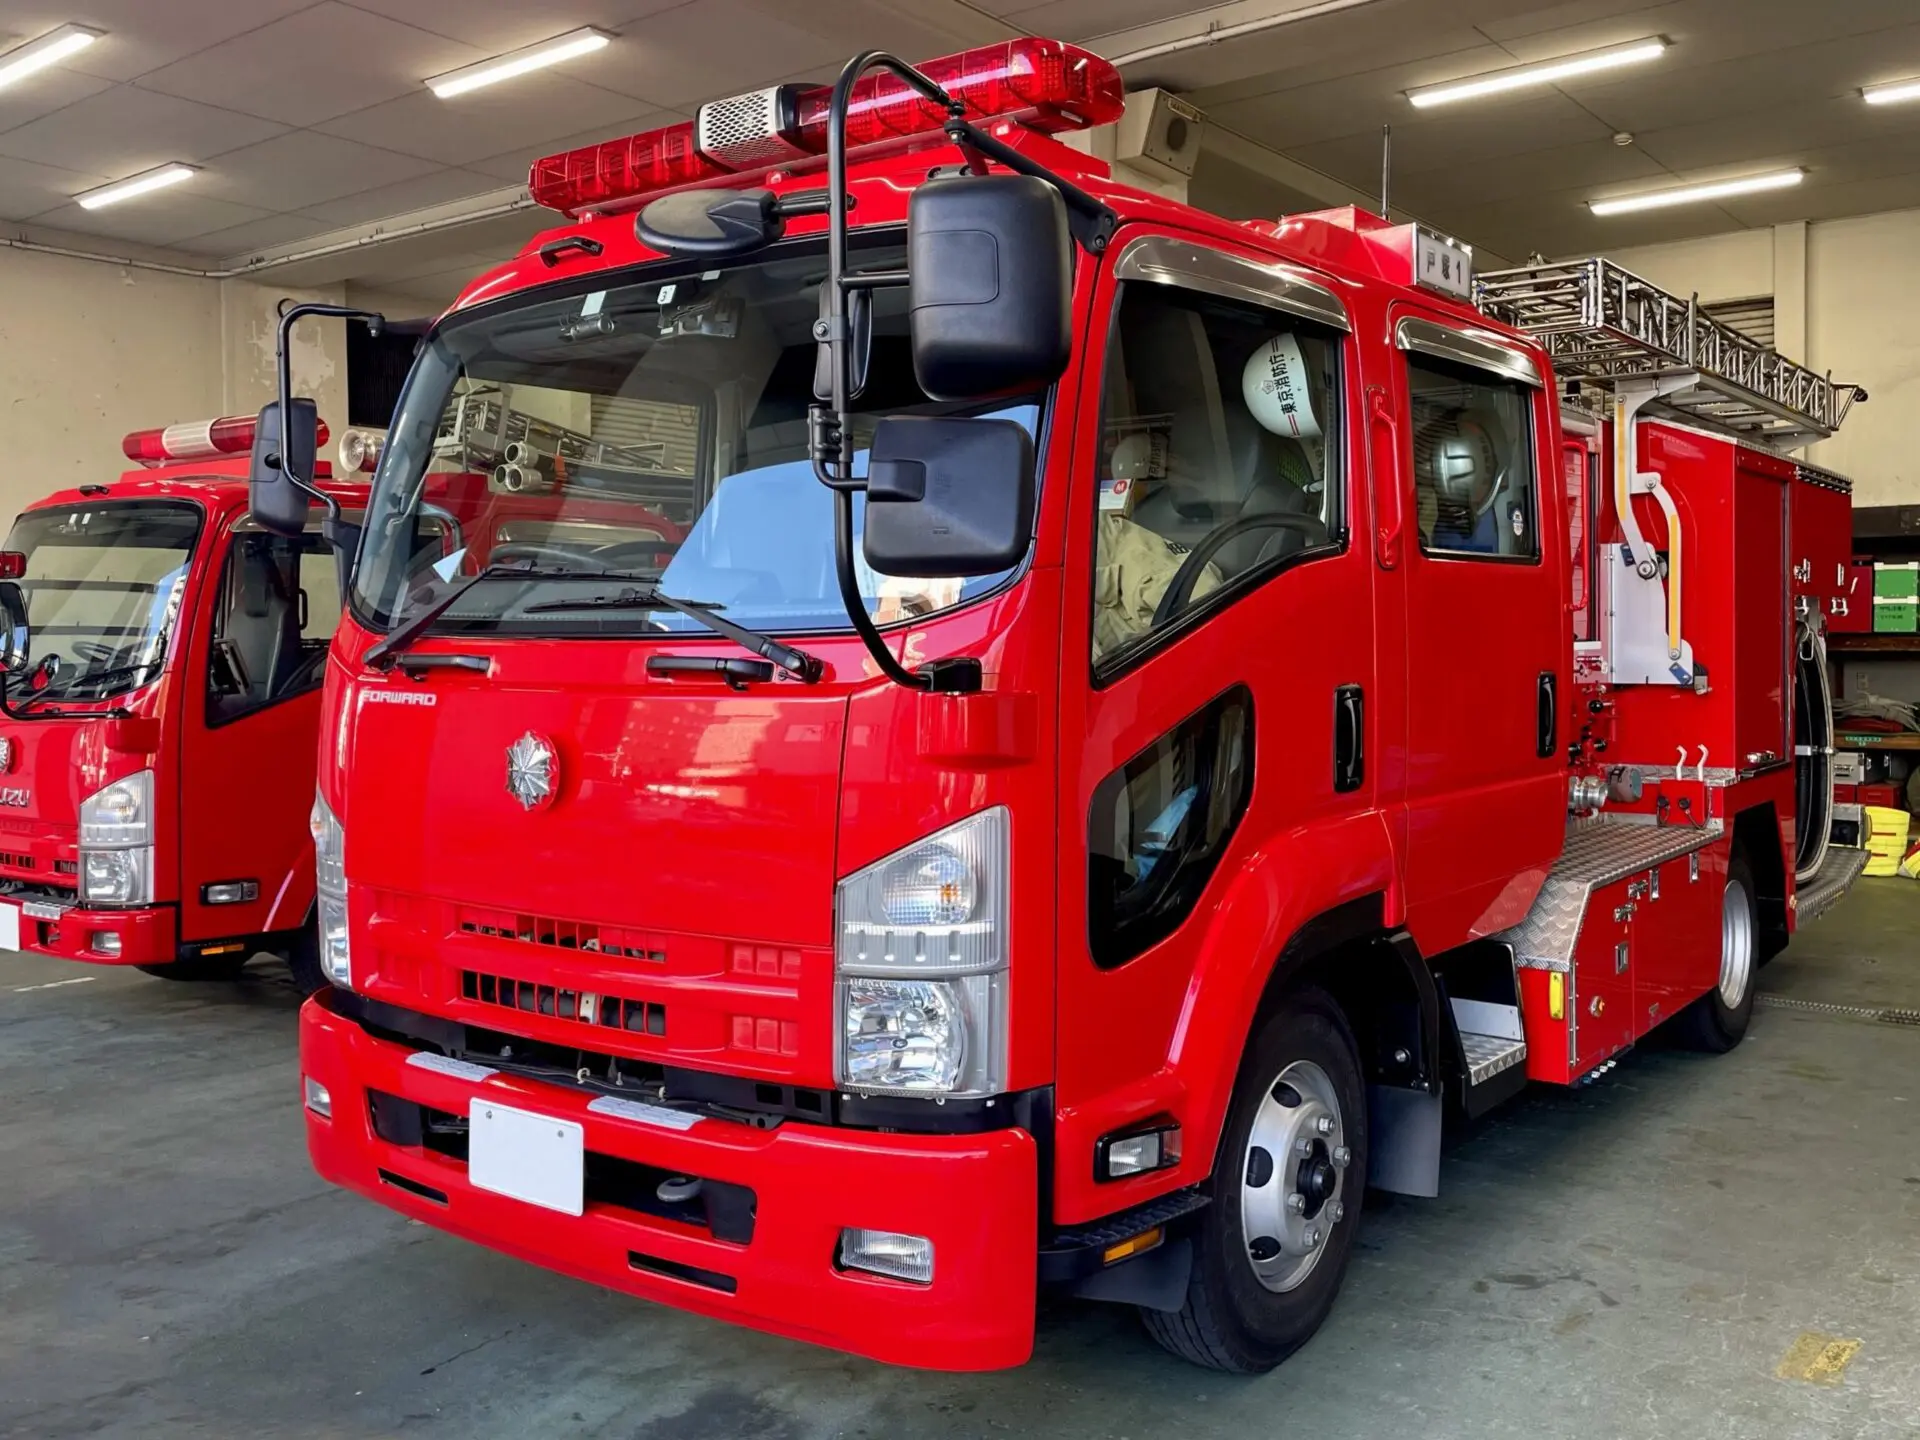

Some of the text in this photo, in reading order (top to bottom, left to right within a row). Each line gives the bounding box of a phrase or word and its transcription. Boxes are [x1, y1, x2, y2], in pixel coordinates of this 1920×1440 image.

[1269, 353, 1298, 415] 東京消防庁
[359, 689, 437, 706] FORWARD
